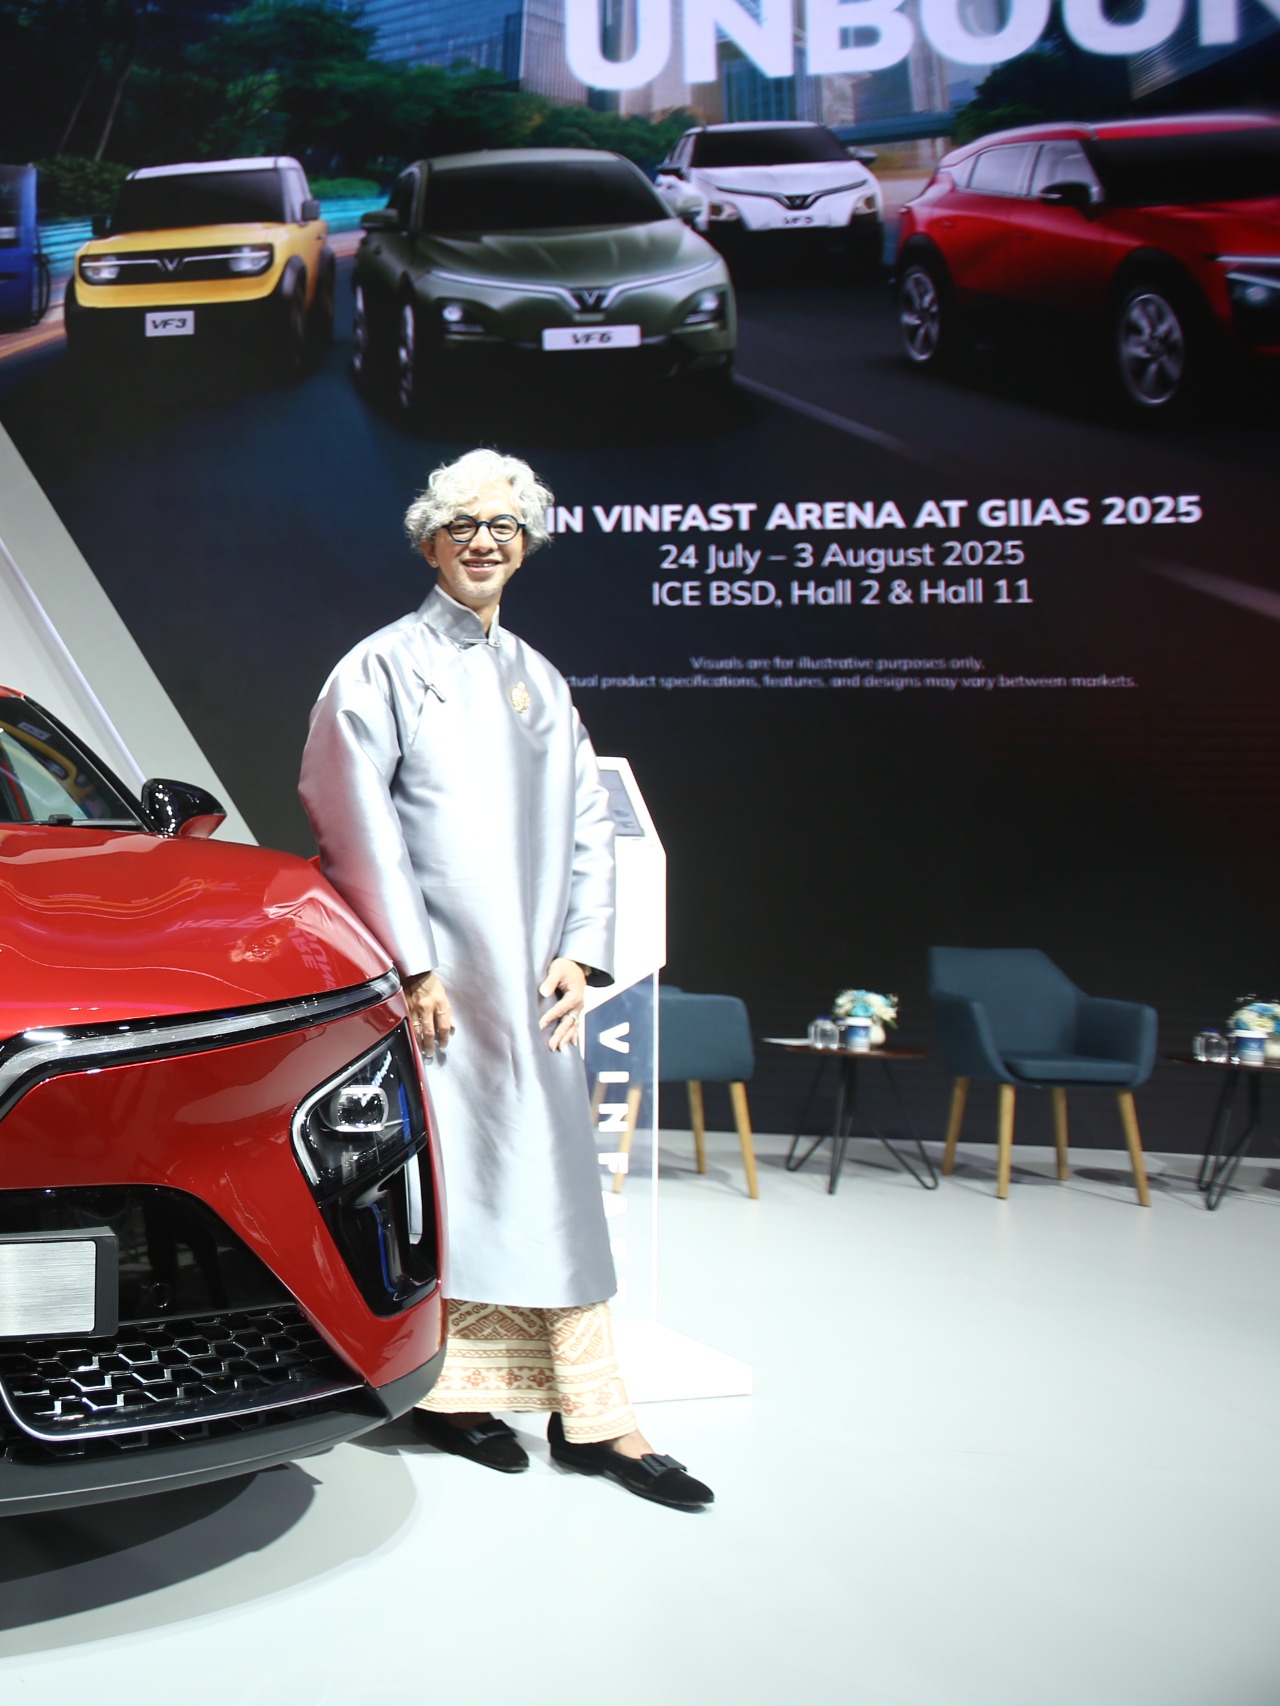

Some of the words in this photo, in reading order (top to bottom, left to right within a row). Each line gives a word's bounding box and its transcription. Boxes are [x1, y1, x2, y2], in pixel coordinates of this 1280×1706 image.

[151, 318, 188, 330] VF3
[572, 330, 613, 344] VF6
[592, 502, 758, 533] VINFAST
[765, 501, 907, 531] ARENA
[913, 499, 969, 529] AT
[977, 497, 1091, 528] GIIAS
[1101, 495, 1203, 525] 2025
[659, 543, 699, 570] 24
[705, 542, 762, 575] July
[794, 542, 814, 568] 3
[821, 541, 935, 574] August
[942, 540, 1026, 566] 2025
[652, 580, 702, 607] ICE
[709, 580, 783, 609] BSD,
[790, 578, 852, 606] Hall
[860, 578, 881, 605] 2
[888, 579, 914, 605] &
[920, 577, 983, 604] Hall
[993, 578, 1033, 604] 11
[689, 656, 744, 670] Visuals
[745, 659, 771, 670] are
[773, 656, 795, 670] for
[797, 656, 874, 670] illustrative
[876, 658, 946, 672] purposes
[950, 656, 986, 672] only.
[600, 673, 656, 690] product
[829, 674, 860, 688] and
[864, 674, 921, 691] designs
[924, 677, 958, 691] may
[962, 677, 996, 691] vary
[998, 674, 1067, 688] between
[1071, 673, 1139, 688] markets.
